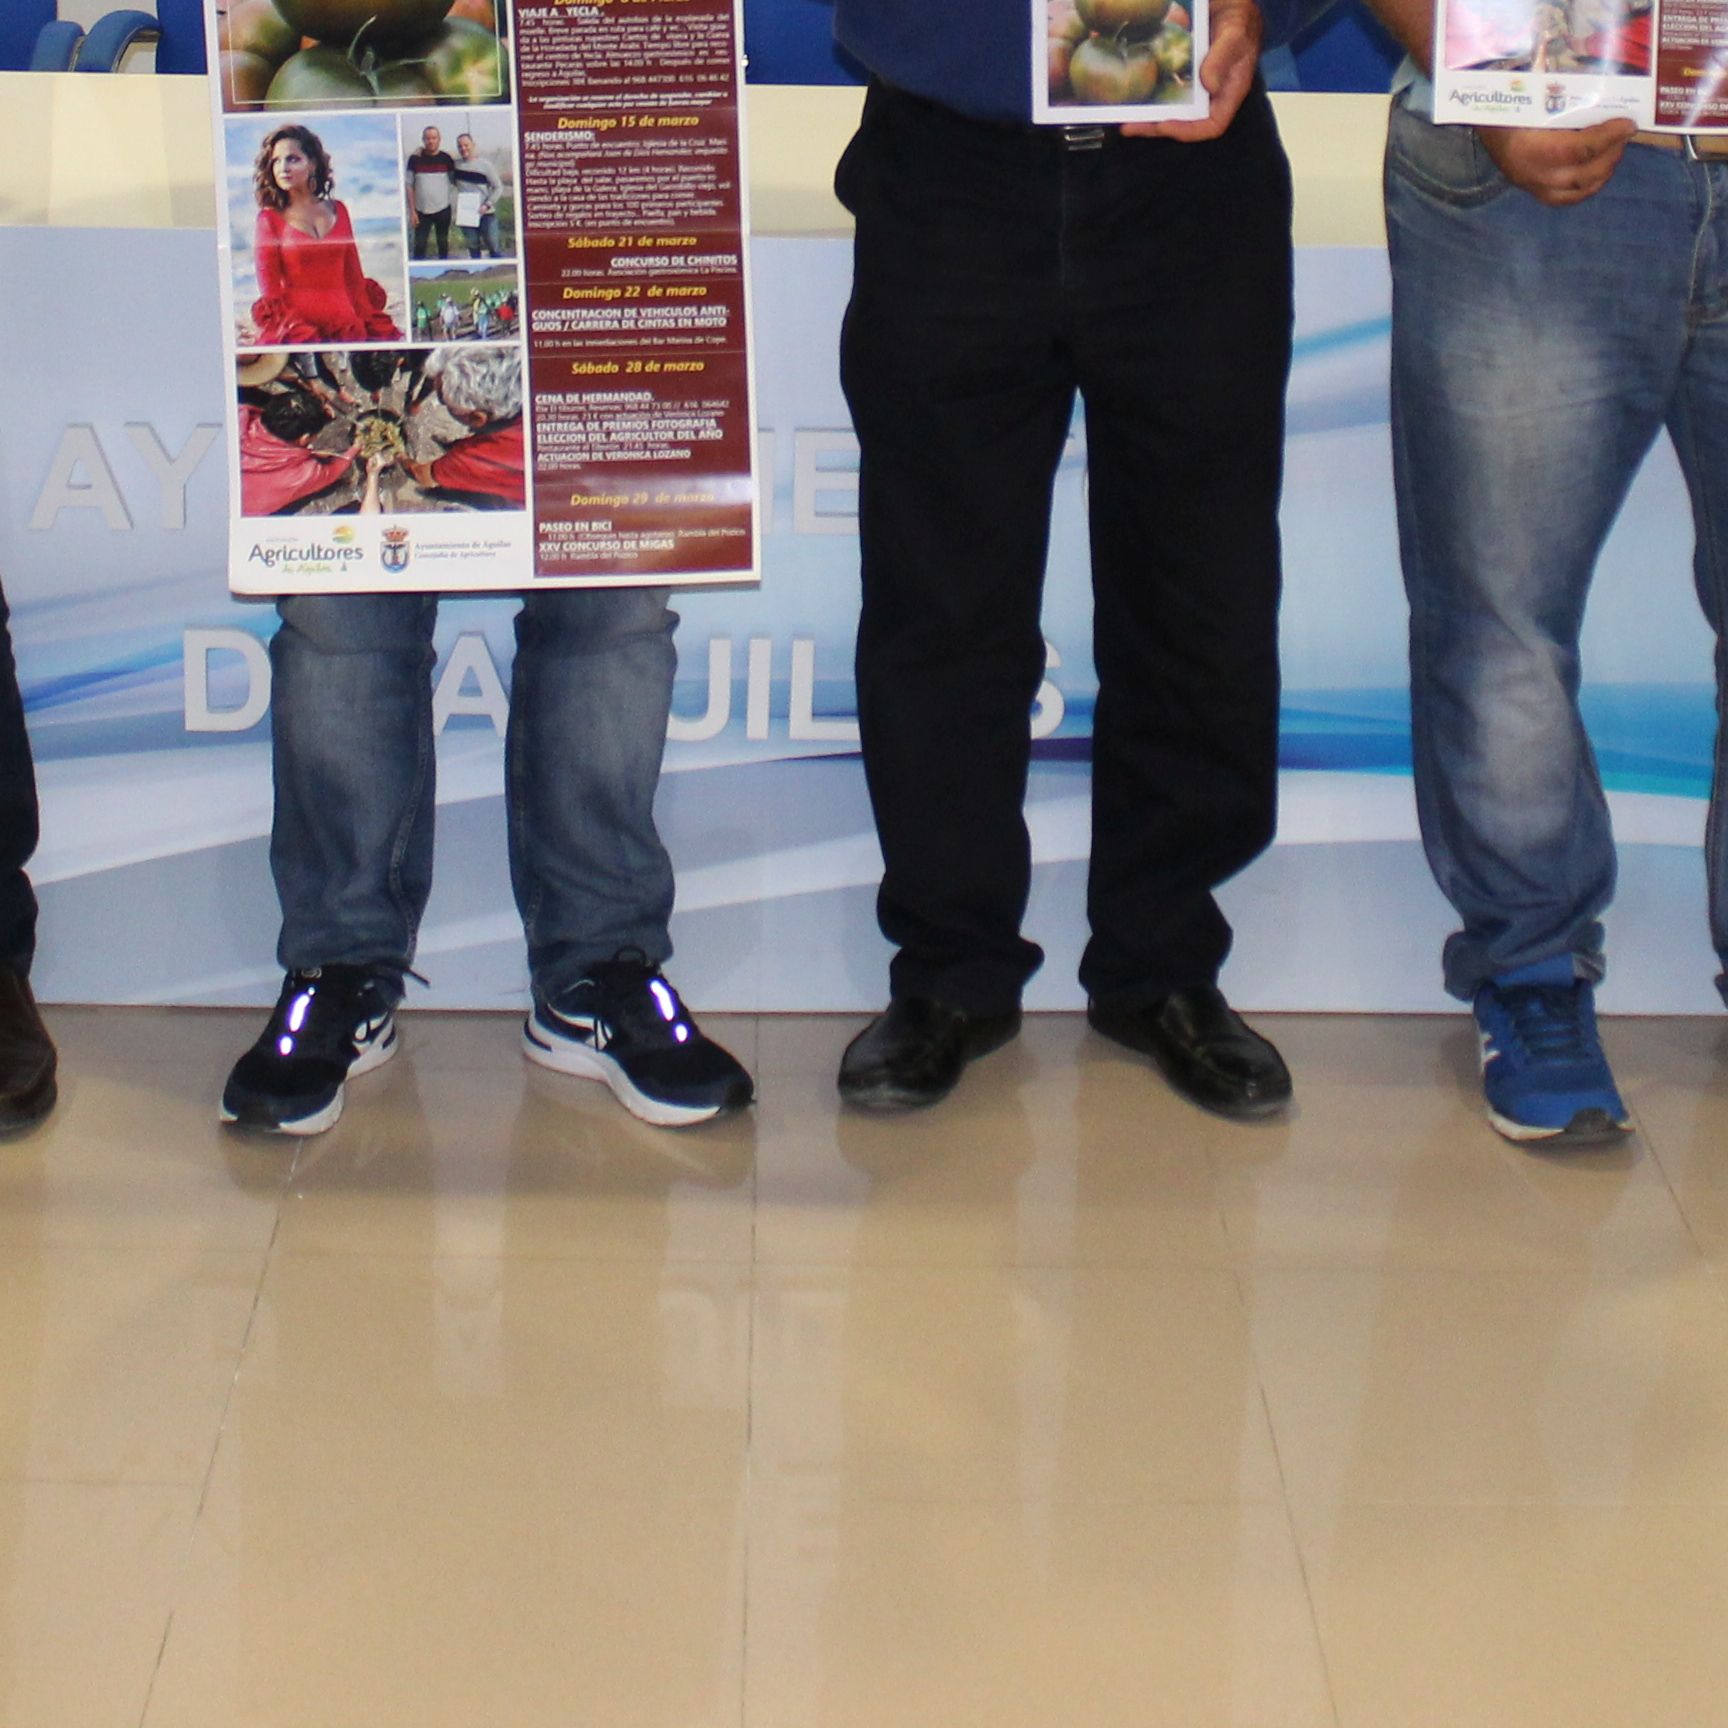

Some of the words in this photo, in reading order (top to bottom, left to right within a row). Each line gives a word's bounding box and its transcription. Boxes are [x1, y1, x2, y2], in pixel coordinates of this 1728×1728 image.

[1450, 89, 1532, 106] Agricultores
[558, 117, 616, 131] Domingo
[621, 116, 635, 127] 15
[639, 116, 654, 127] de
[657, 115, 699, 126] marzo
[568, 237, 615, 249] Sábado
[618, 236, 633, 247] 21
[638, 236, 653, 246] de
[656, 235, 697, 246] marzo
[610, 256, 669, 267] CONCURSO
[672, 256, 685, 266] DE
[688, 255, 737, 265] CHINITOS
[563, 287, 621, 301] Domingo
[624, 286, 640, 298] 22
[648, 286, 662, 297] de
[666, 285, 707, 296] marzo
[571, 362, 619, 374] Sábado
[626, 361, 642, 373] 28
[645, 361, 660, 372] de
[664, 360, 705, 372] marzo
[248, 543, 363, 567] Agricultores
